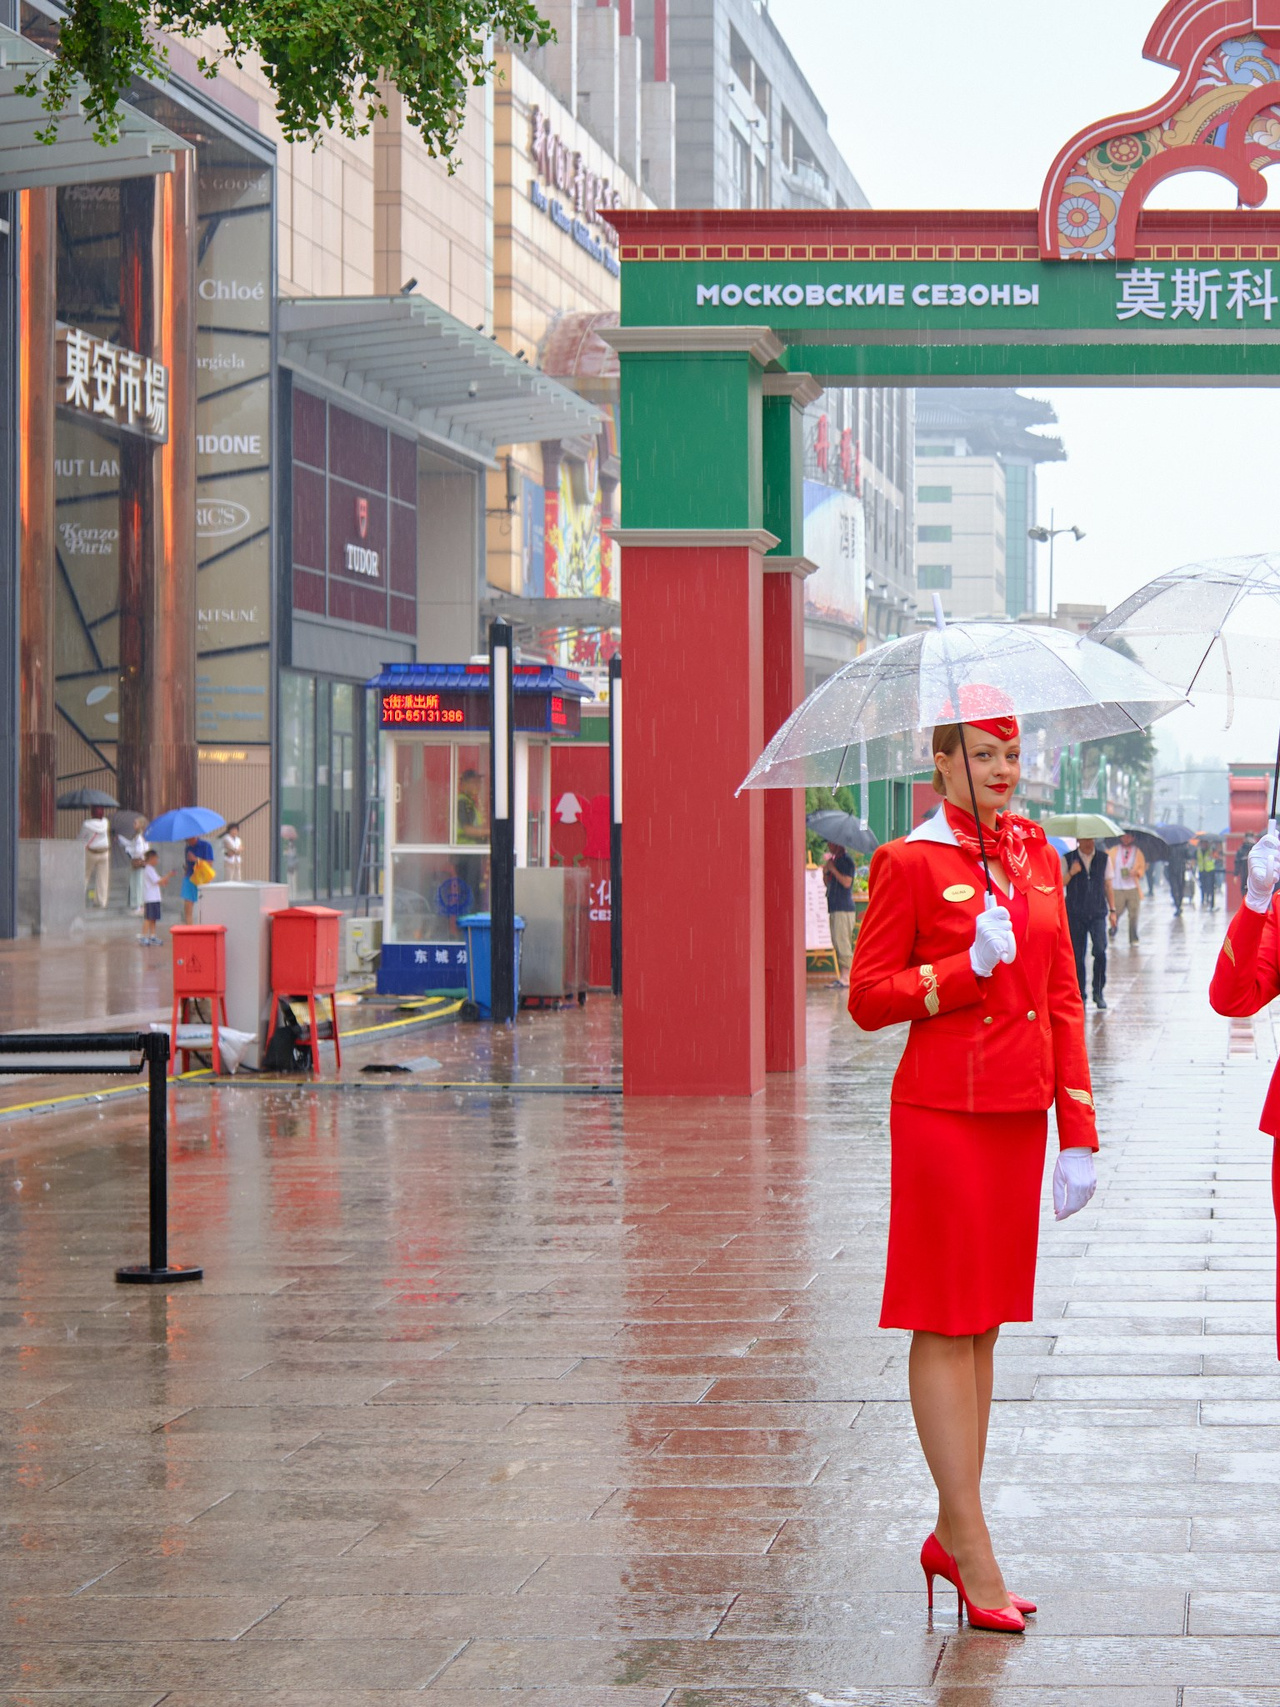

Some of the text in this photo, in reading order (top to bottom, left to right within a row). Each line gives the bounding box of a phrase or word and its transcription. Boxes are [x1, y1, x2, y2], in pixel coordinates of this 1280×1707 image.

[199, 279, 264, 300] Chloé
[696, 284, 1039, 306] МОСКОВСКИЕ СЕЗОНЫ
[66, 329, 166, 435] 東安市場
[59, 522, 119, 541] Kenzo
[65, 537, 112, 555] Paris
[347, 543, 380, 577] TUDOR
